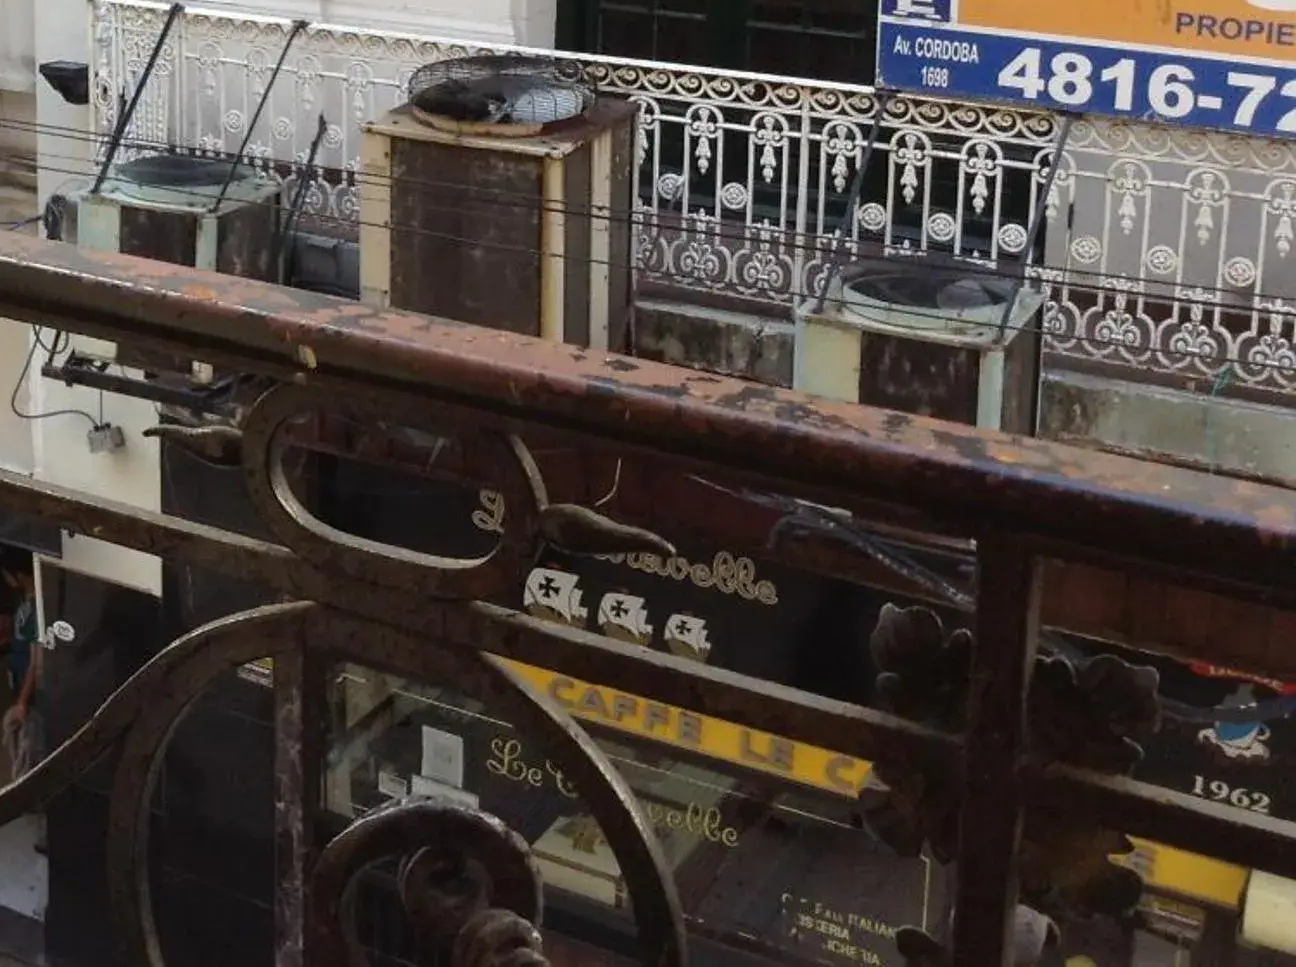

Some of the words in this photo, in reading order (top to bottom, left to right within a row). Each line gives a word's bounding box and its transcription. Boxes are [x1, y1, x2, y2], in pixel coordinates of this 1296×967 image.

[1175, 12, 1296, 46] PROPIE
[893, 34, 912, 56] Av.
[915, 37, 979, 64] CORDOBA
[921, 66, 950, 88] 1698
[1193, 775, 1271, 814] 1962
